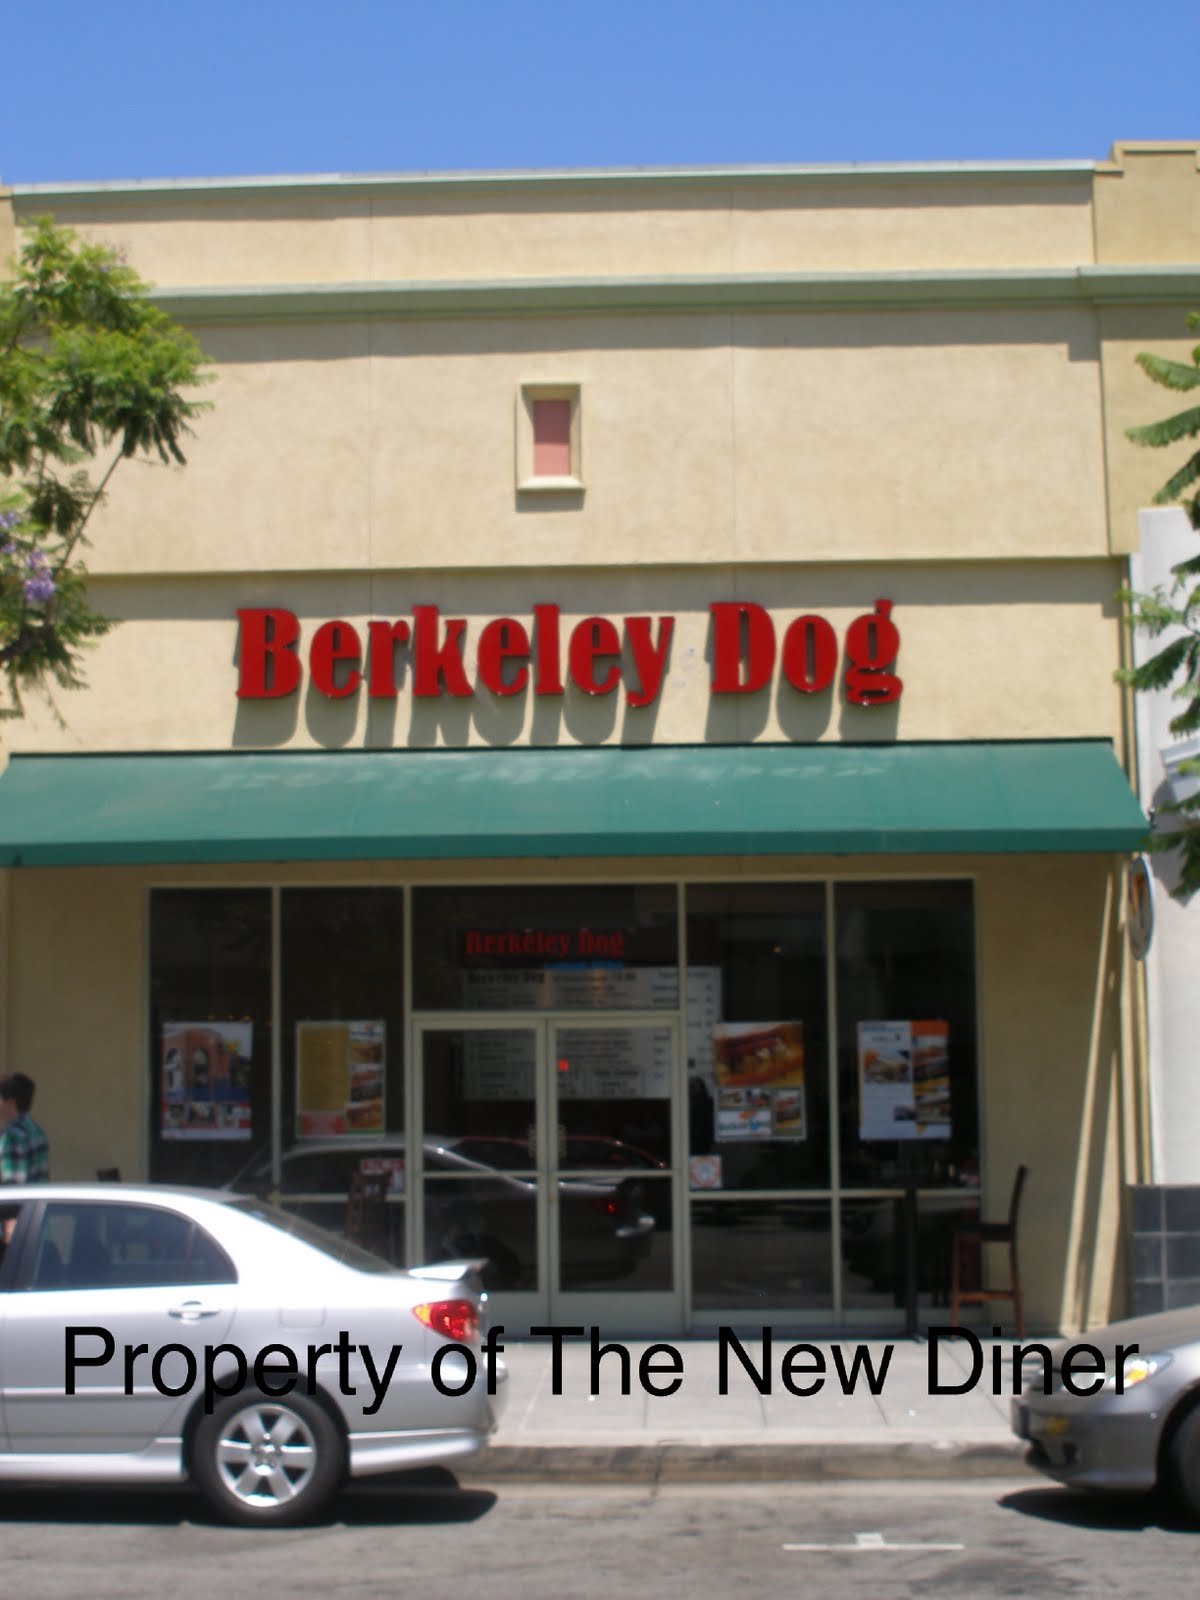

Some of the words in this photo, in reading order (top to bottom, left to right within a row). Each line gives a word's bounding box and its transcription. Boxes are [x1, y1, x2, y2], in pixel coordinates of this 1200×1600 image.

[236, 605, 674, 706] Berkeley
[709, 600, 903, 704] Dog
[464, 930, 569, 957] Berkeley
[577, 929, 624, 956] Dog
